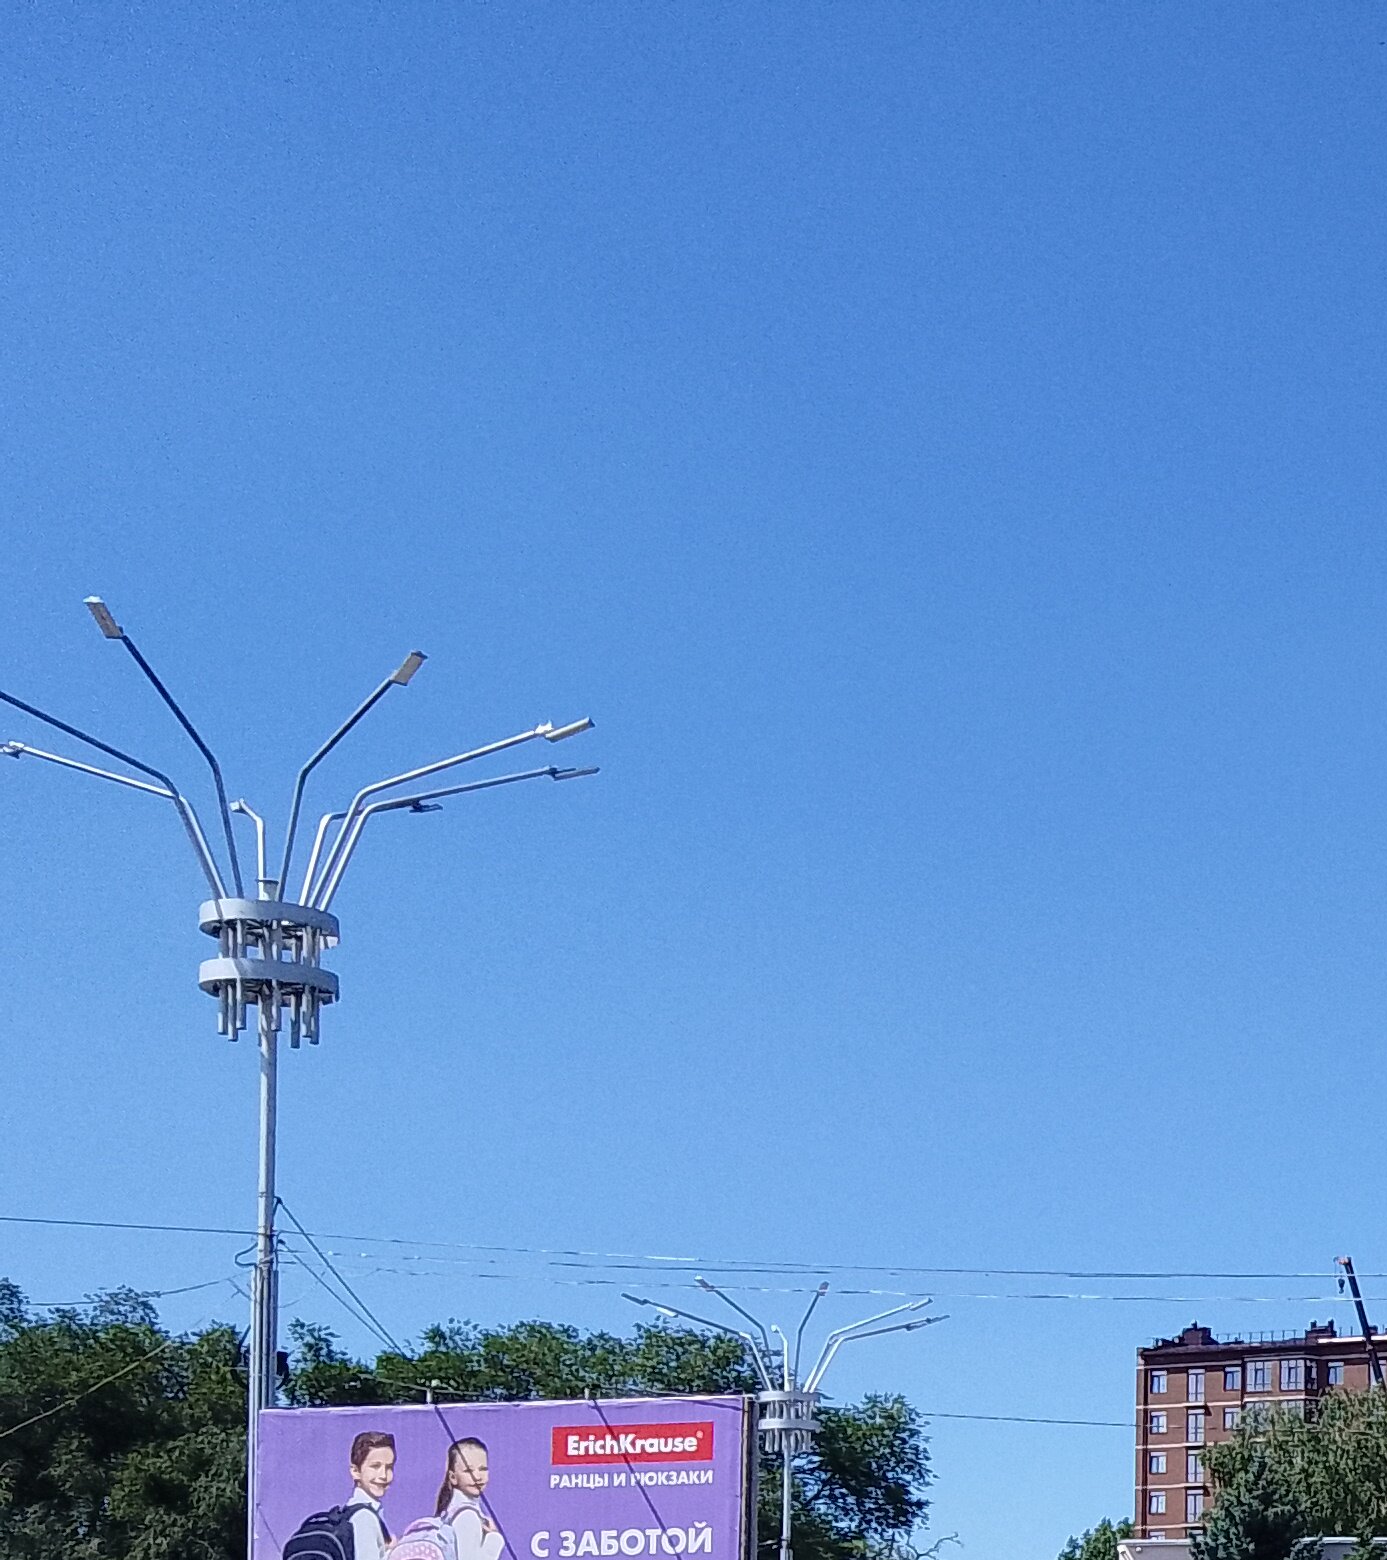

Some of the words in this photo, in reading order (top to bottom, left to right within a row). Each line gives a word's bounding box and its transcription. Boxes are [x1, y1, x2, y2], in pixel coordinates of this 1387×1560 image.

[566, 1433, 698, 1456] ErichKrause
[550, 1472, 609, 1489] РАНЦЫ
[613, 1473, 626, 1486] И
[630, 1470, 714, 1486] РЮКЗАКИ
[531, 1531, 550, 1558] С
[559, 1521, 712, 1557] ЗАБОТОЙ
